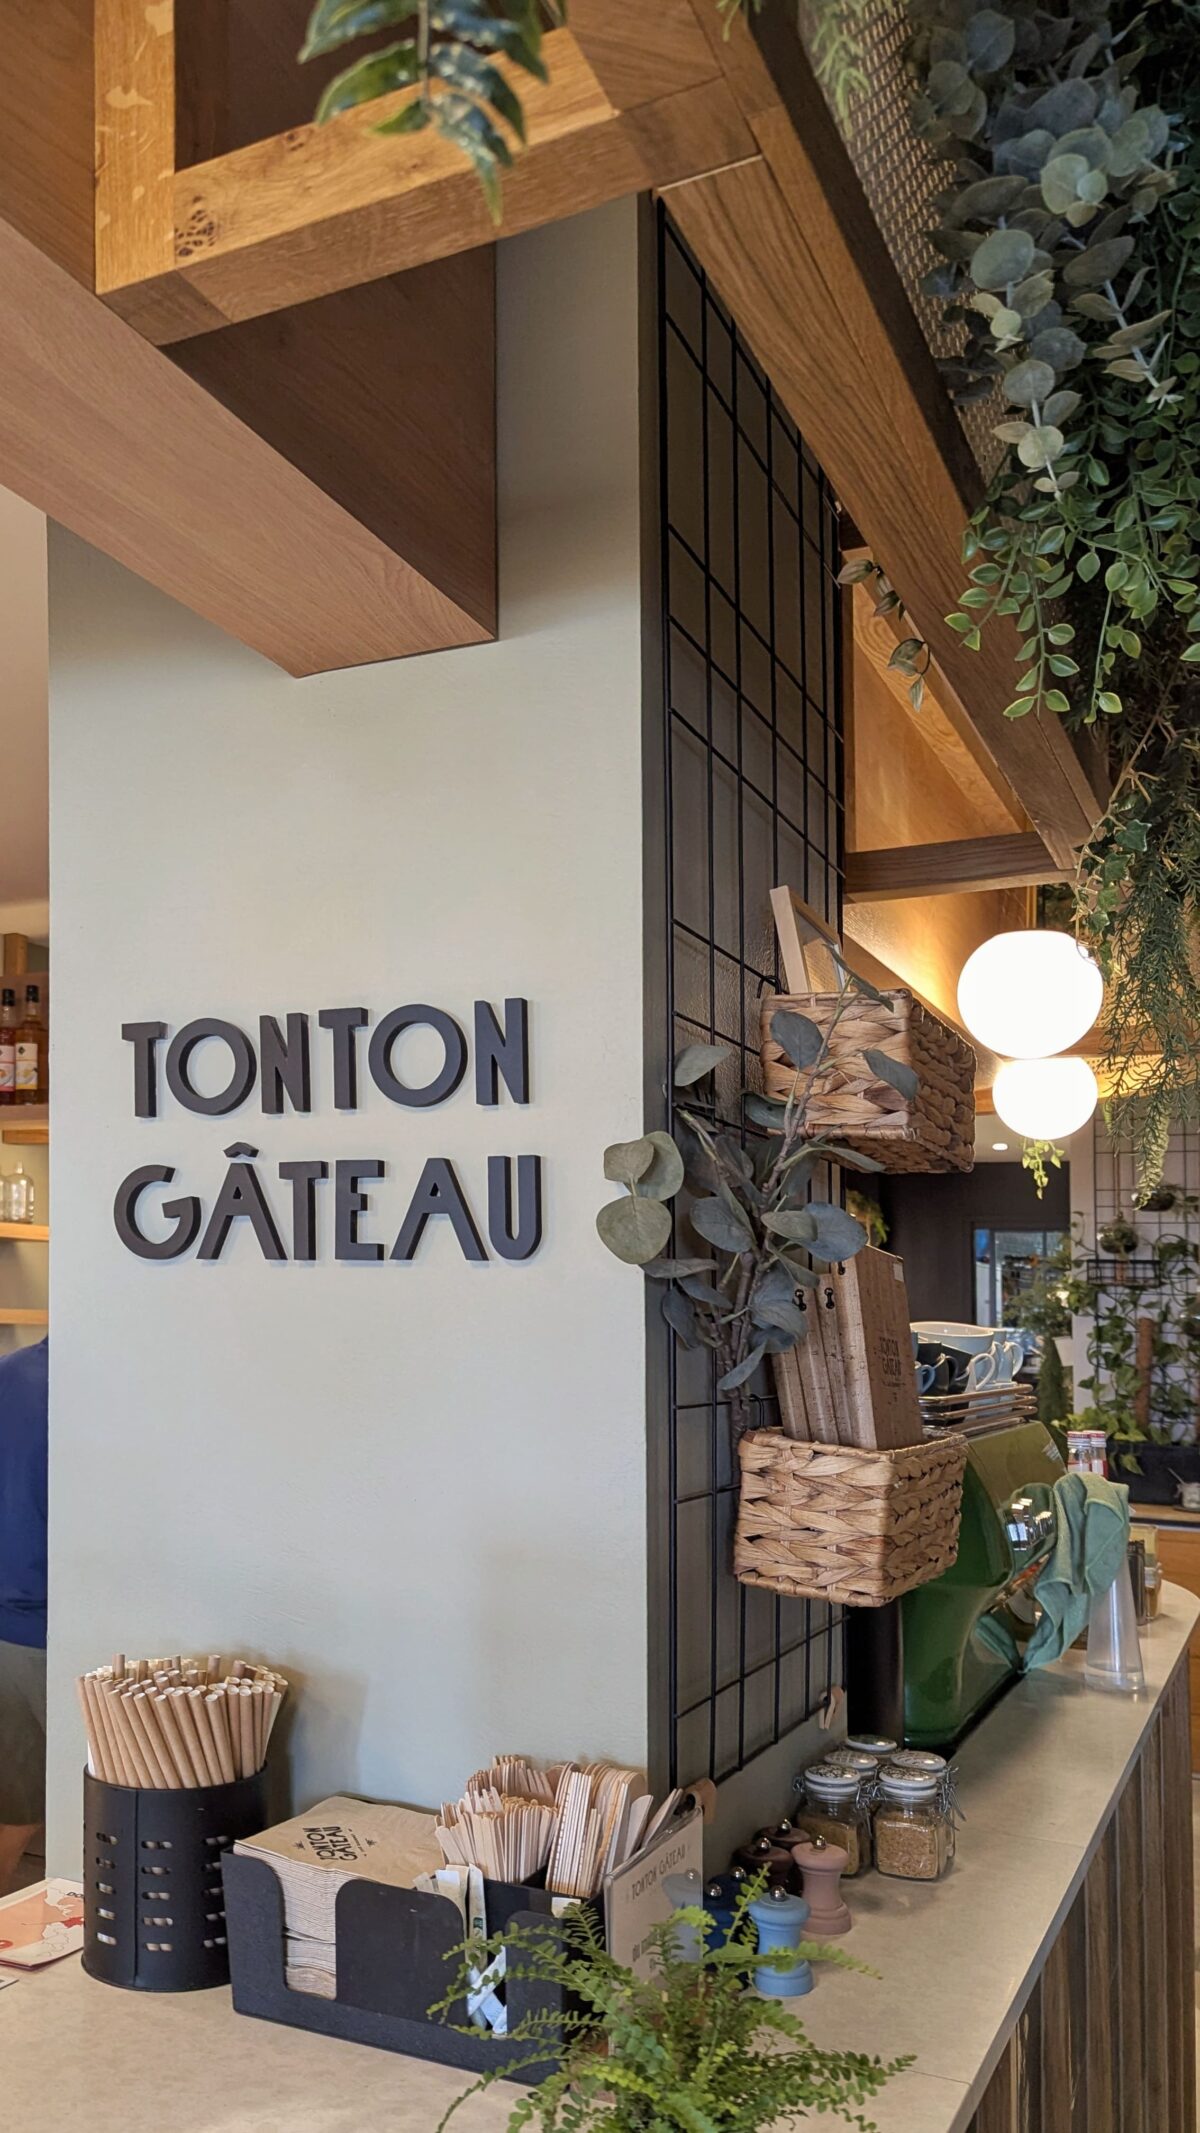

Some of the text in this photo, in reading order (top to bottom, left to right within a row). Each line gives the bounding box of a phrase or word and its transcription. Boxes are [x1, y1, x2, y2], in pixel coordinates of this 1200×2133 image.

[121, 997, 530, 1118] TONTON
[113, 1141, 542, 1261] GÂTEAU
[302, 1827, 339, 1860] TONTON
[631, 1866, 657, 1900] TONTON
